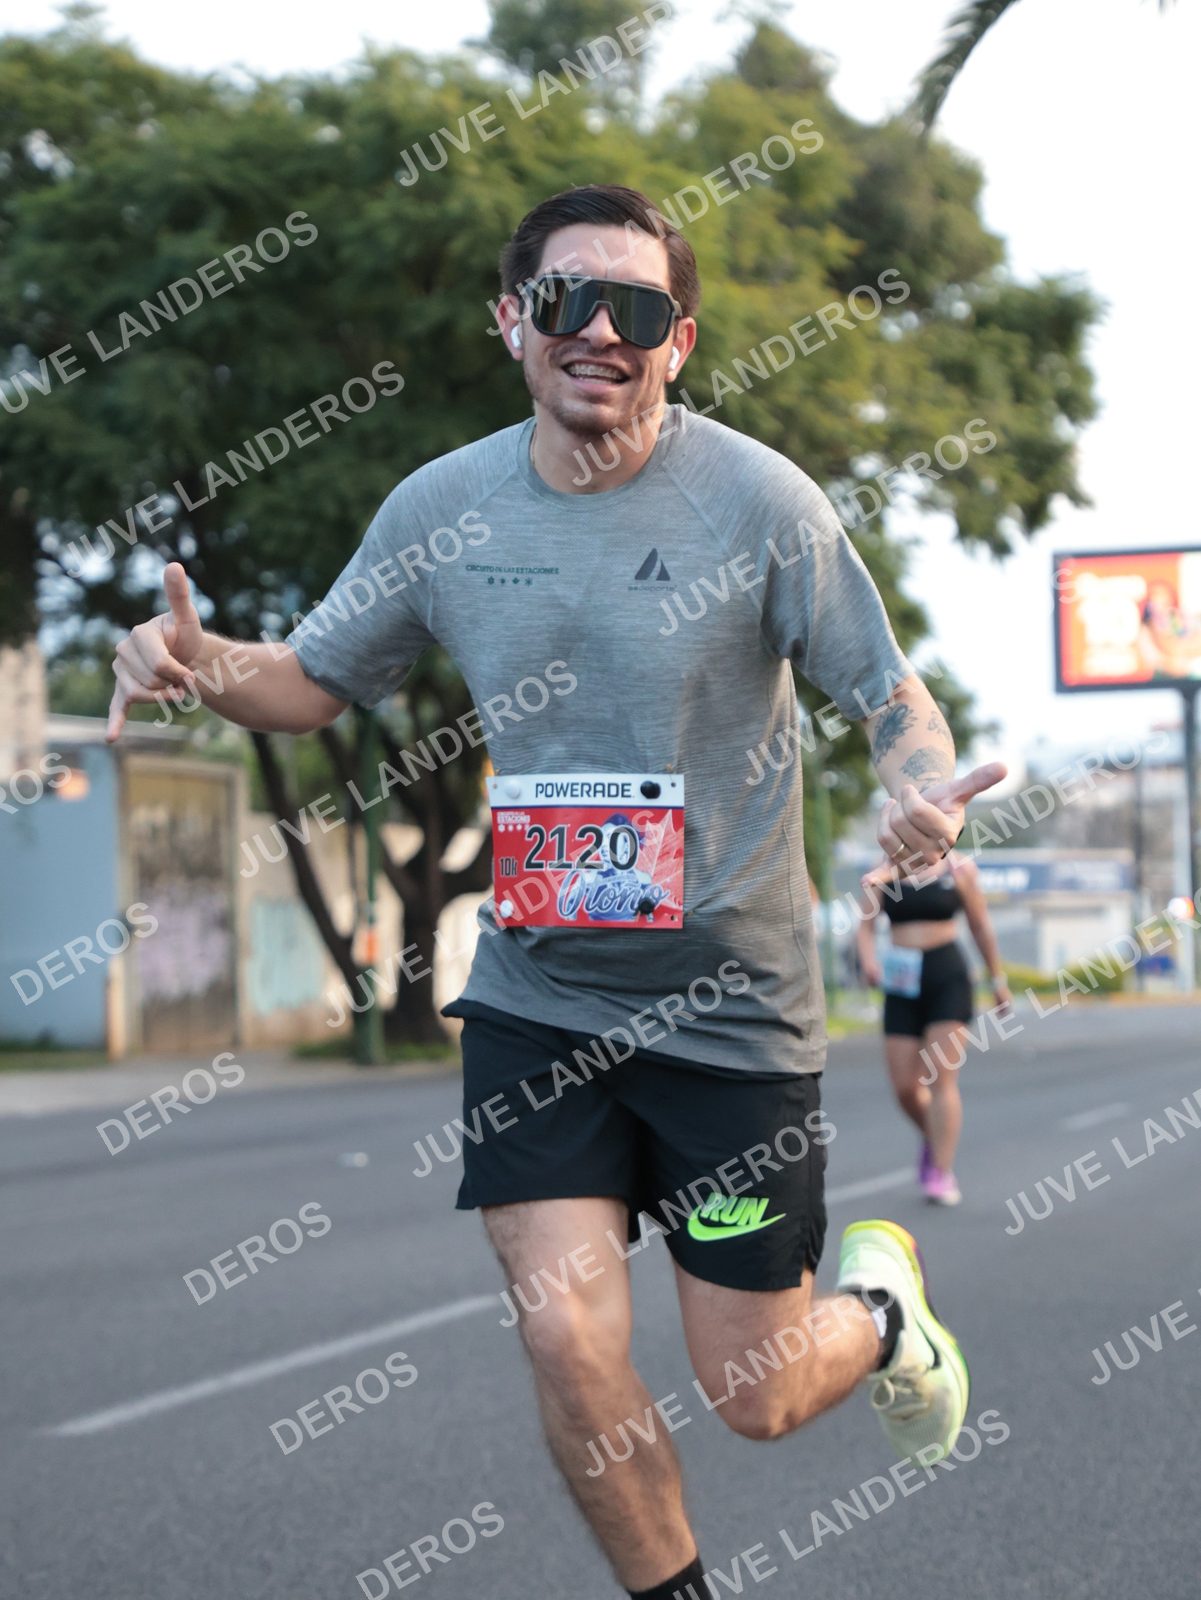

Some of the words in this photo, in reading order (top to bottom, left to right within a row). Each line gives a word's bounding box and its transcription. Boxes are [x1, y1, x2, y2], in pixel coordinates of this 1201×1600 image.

[535, 782, 632, 798] POWERADE
[524, 823, 639, 871] 2120
[700, 1192, 769, 1226] RUN
